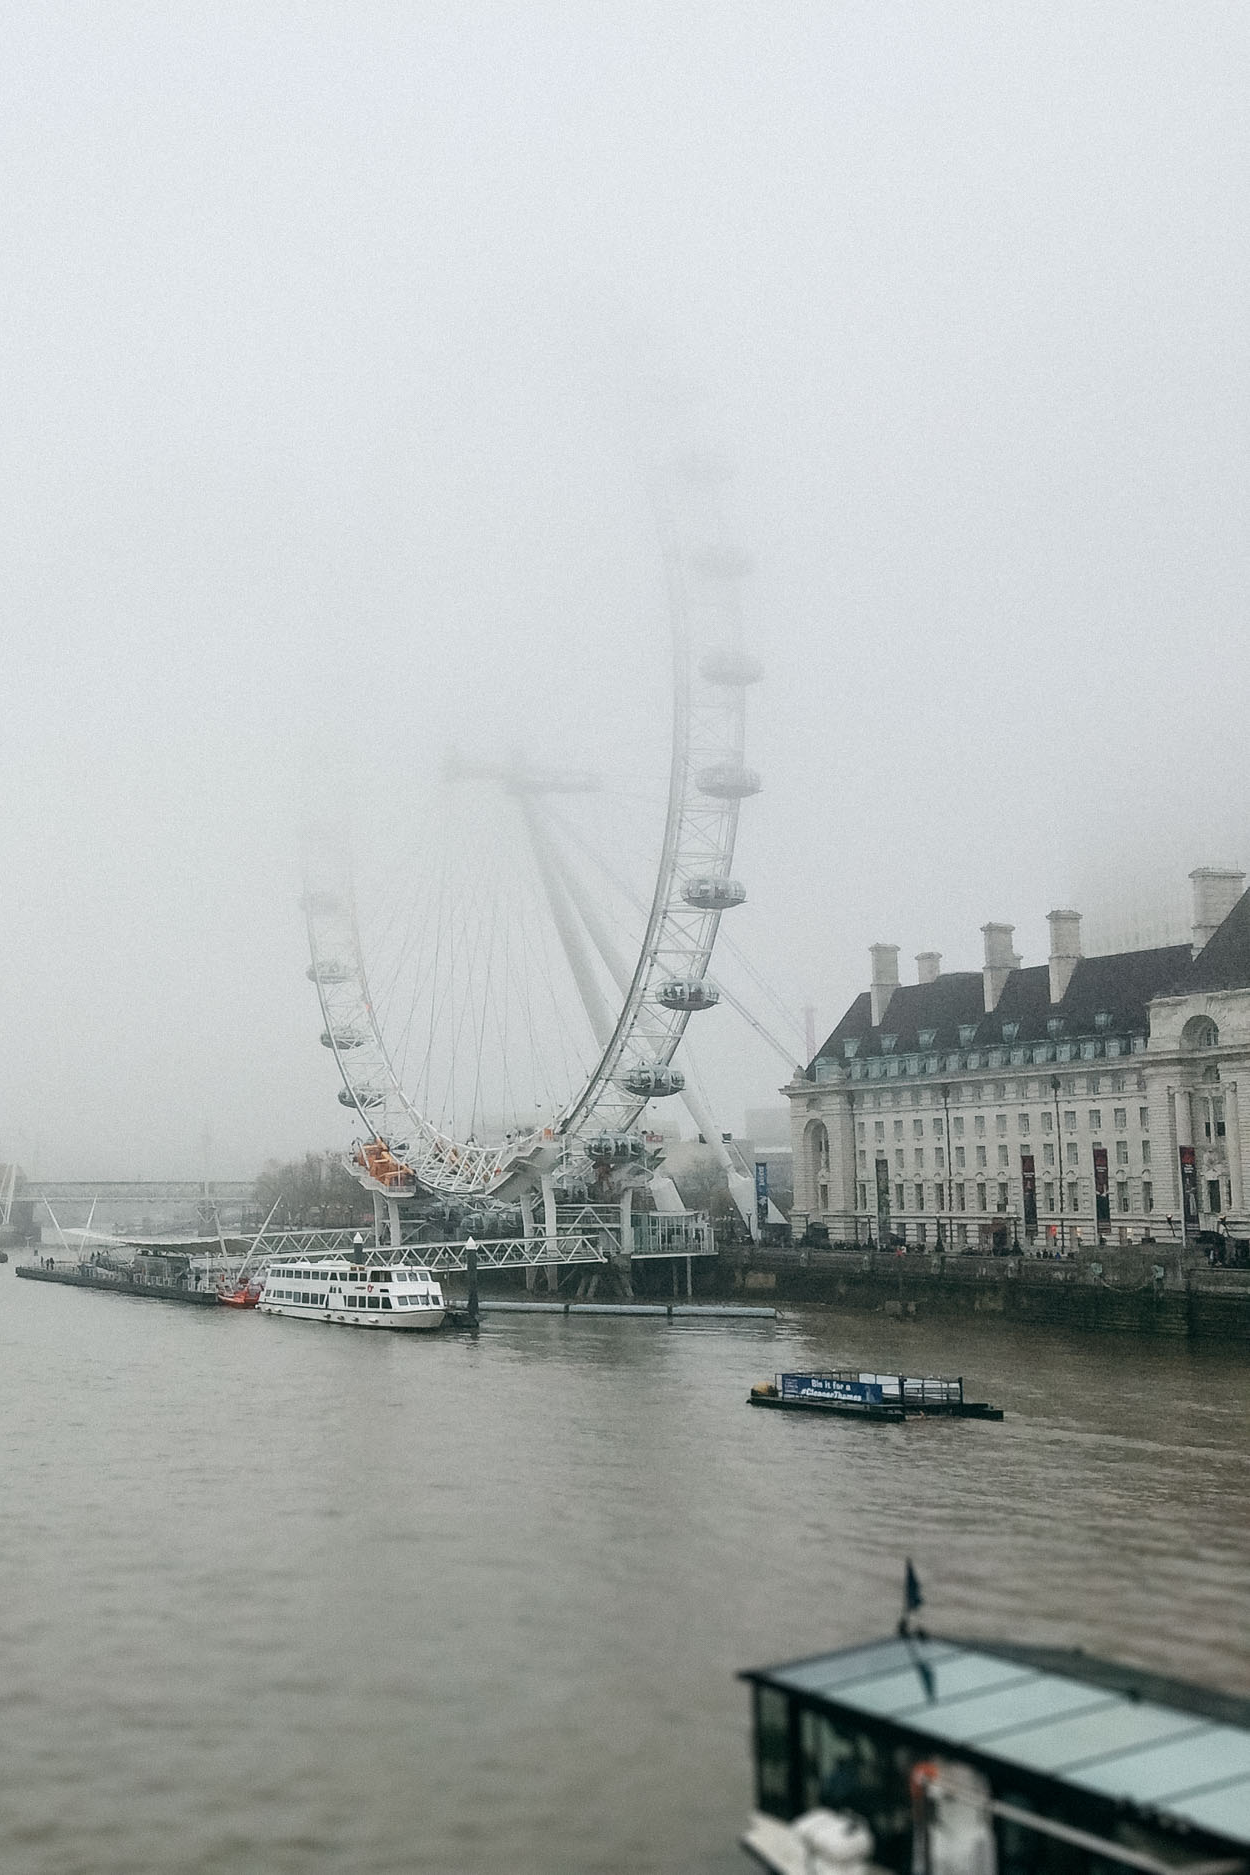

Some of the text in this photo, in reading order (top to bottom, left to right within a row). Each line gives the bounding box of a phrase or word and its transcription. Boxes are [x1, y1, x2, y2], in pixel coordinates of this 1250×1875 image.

[811, 1379, 823, 1388] Bin
[825, 1380, 831, 1389] it
[833, 1381, 844, 1390] for
[801, 1388, 862, 1401] #CleanerThames
